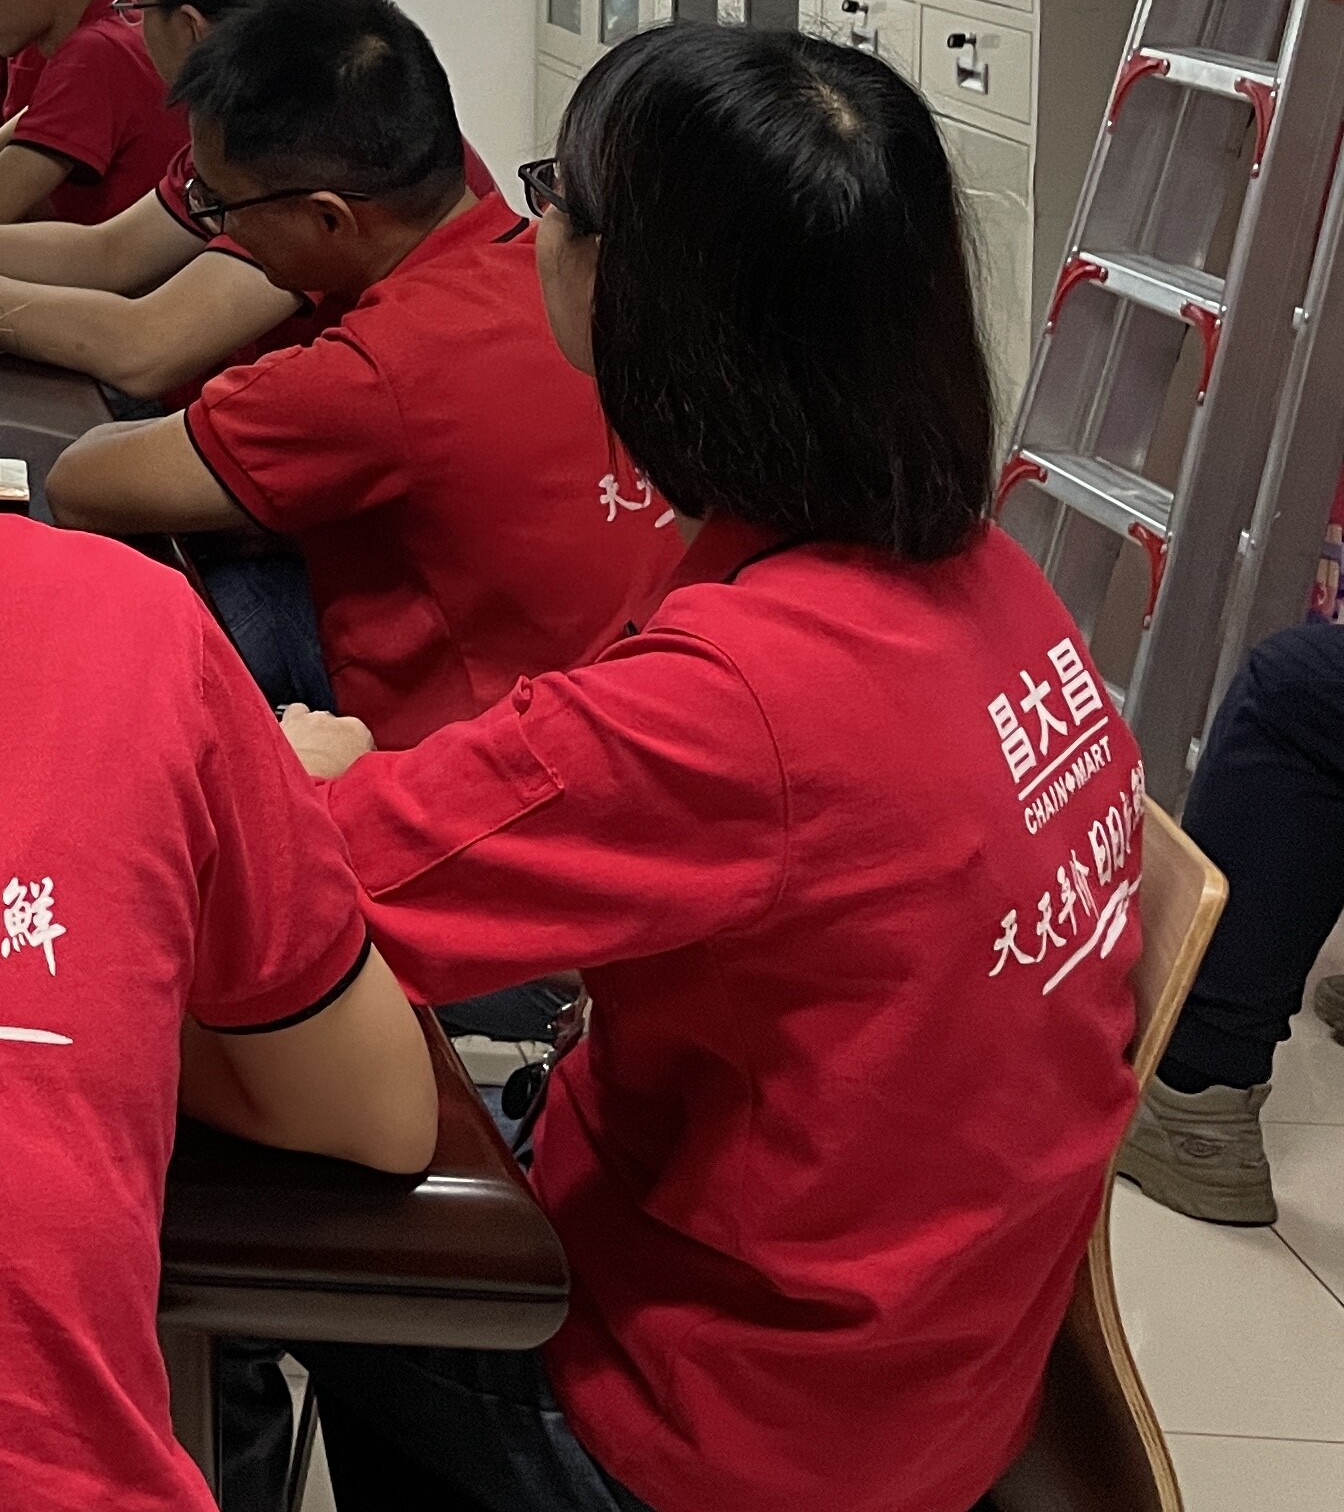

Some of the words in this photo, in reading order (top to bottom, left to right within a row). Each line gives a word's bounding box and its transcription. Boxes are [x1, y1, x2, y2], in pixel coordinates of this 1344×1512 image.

[987, 636, 1103, 784] 昌大昌
[1023, 782, 1069, 836] CHAIN
[1071, 734, 1113, 793] MART
